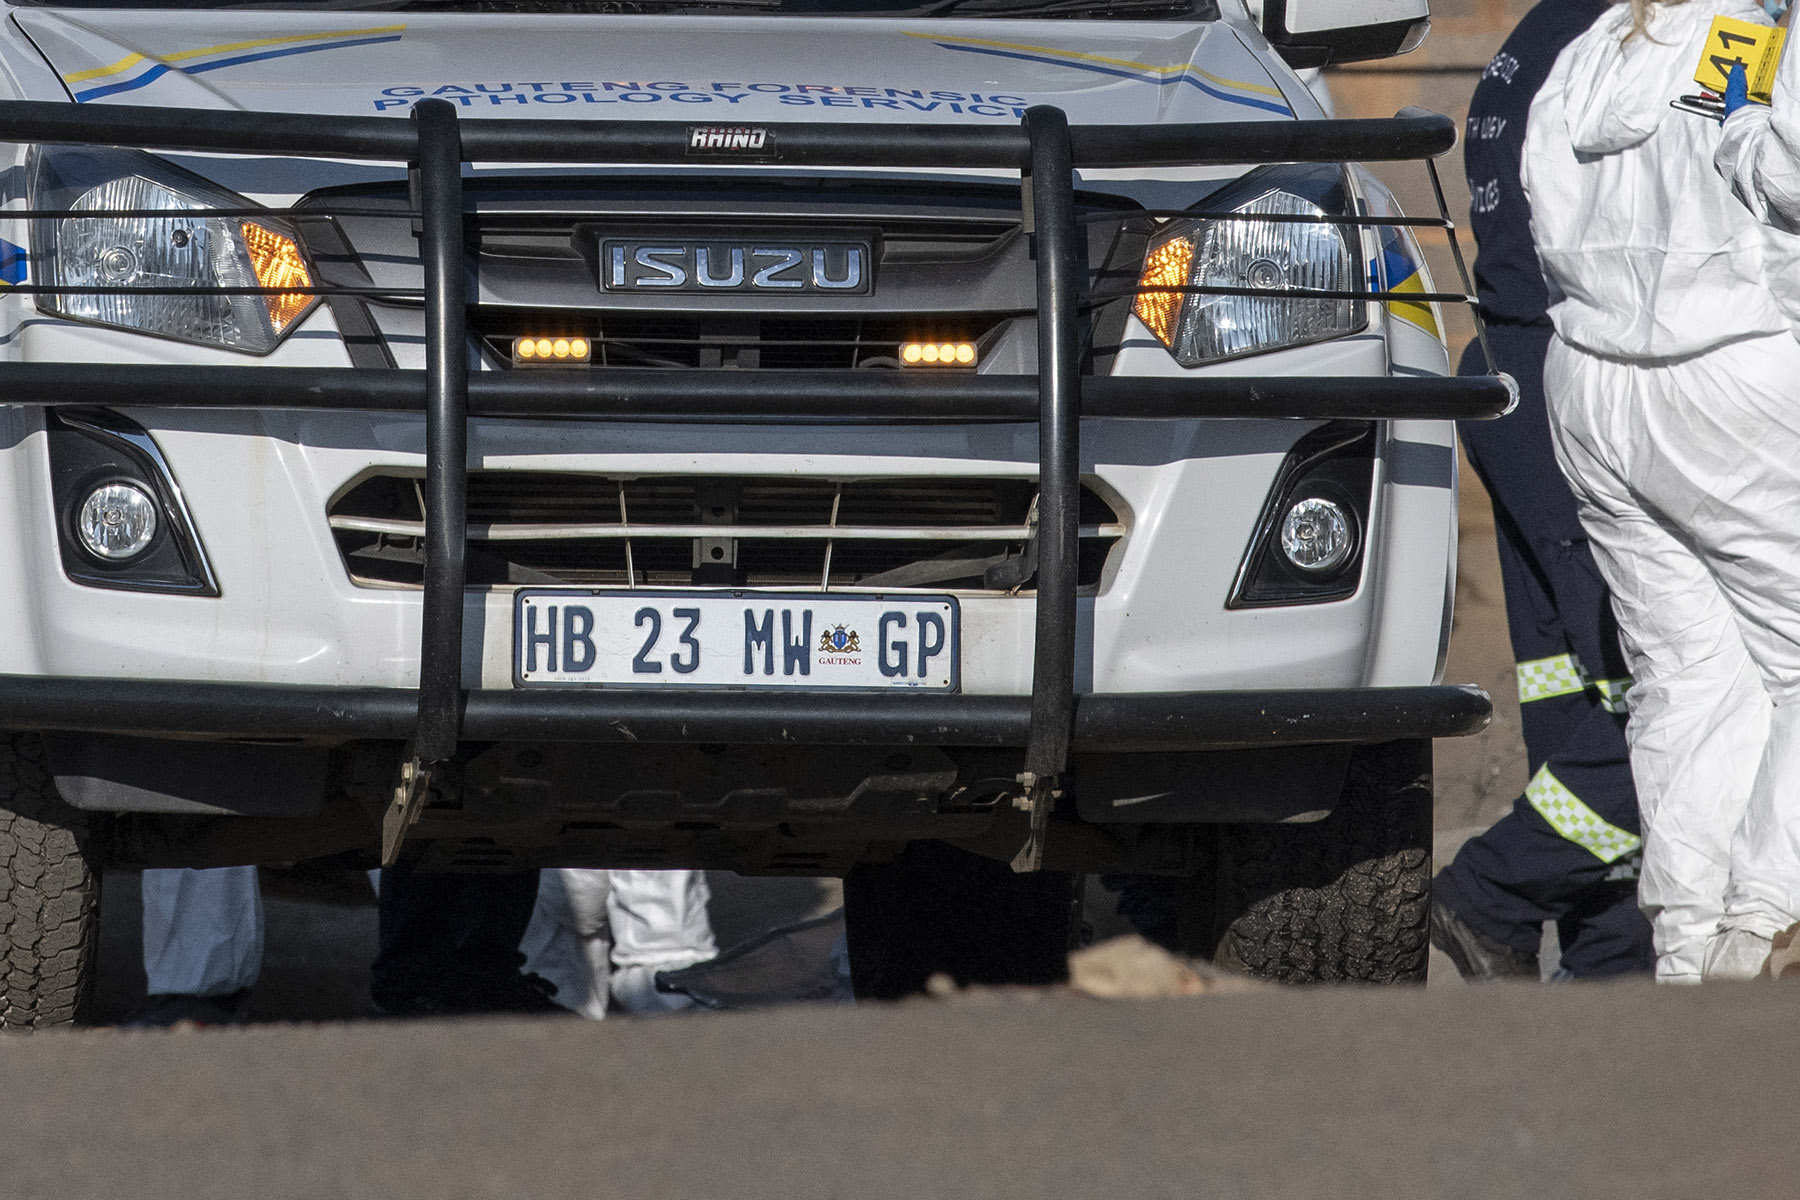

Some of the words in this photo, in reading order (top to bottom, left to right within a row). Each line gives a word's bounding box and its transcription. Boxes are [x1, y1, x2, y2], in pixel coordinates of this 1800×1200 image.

[373, 92, 751, 111] PTHOLOGY
[381, 81, 690, 97] GAUTENG
[711, 82, 1029, 106] FORENSIC
[690, 128, 766, 148] RHINO
[611, 246, 861, 288] ISUZU
[526, 604, 598, 674] HB
[631, 606, 702, 675] 23
[743, 608, 813, 677] MW
[877, 610, 947, 679] GP
[818, 657, 862, 666] GAUTENG
